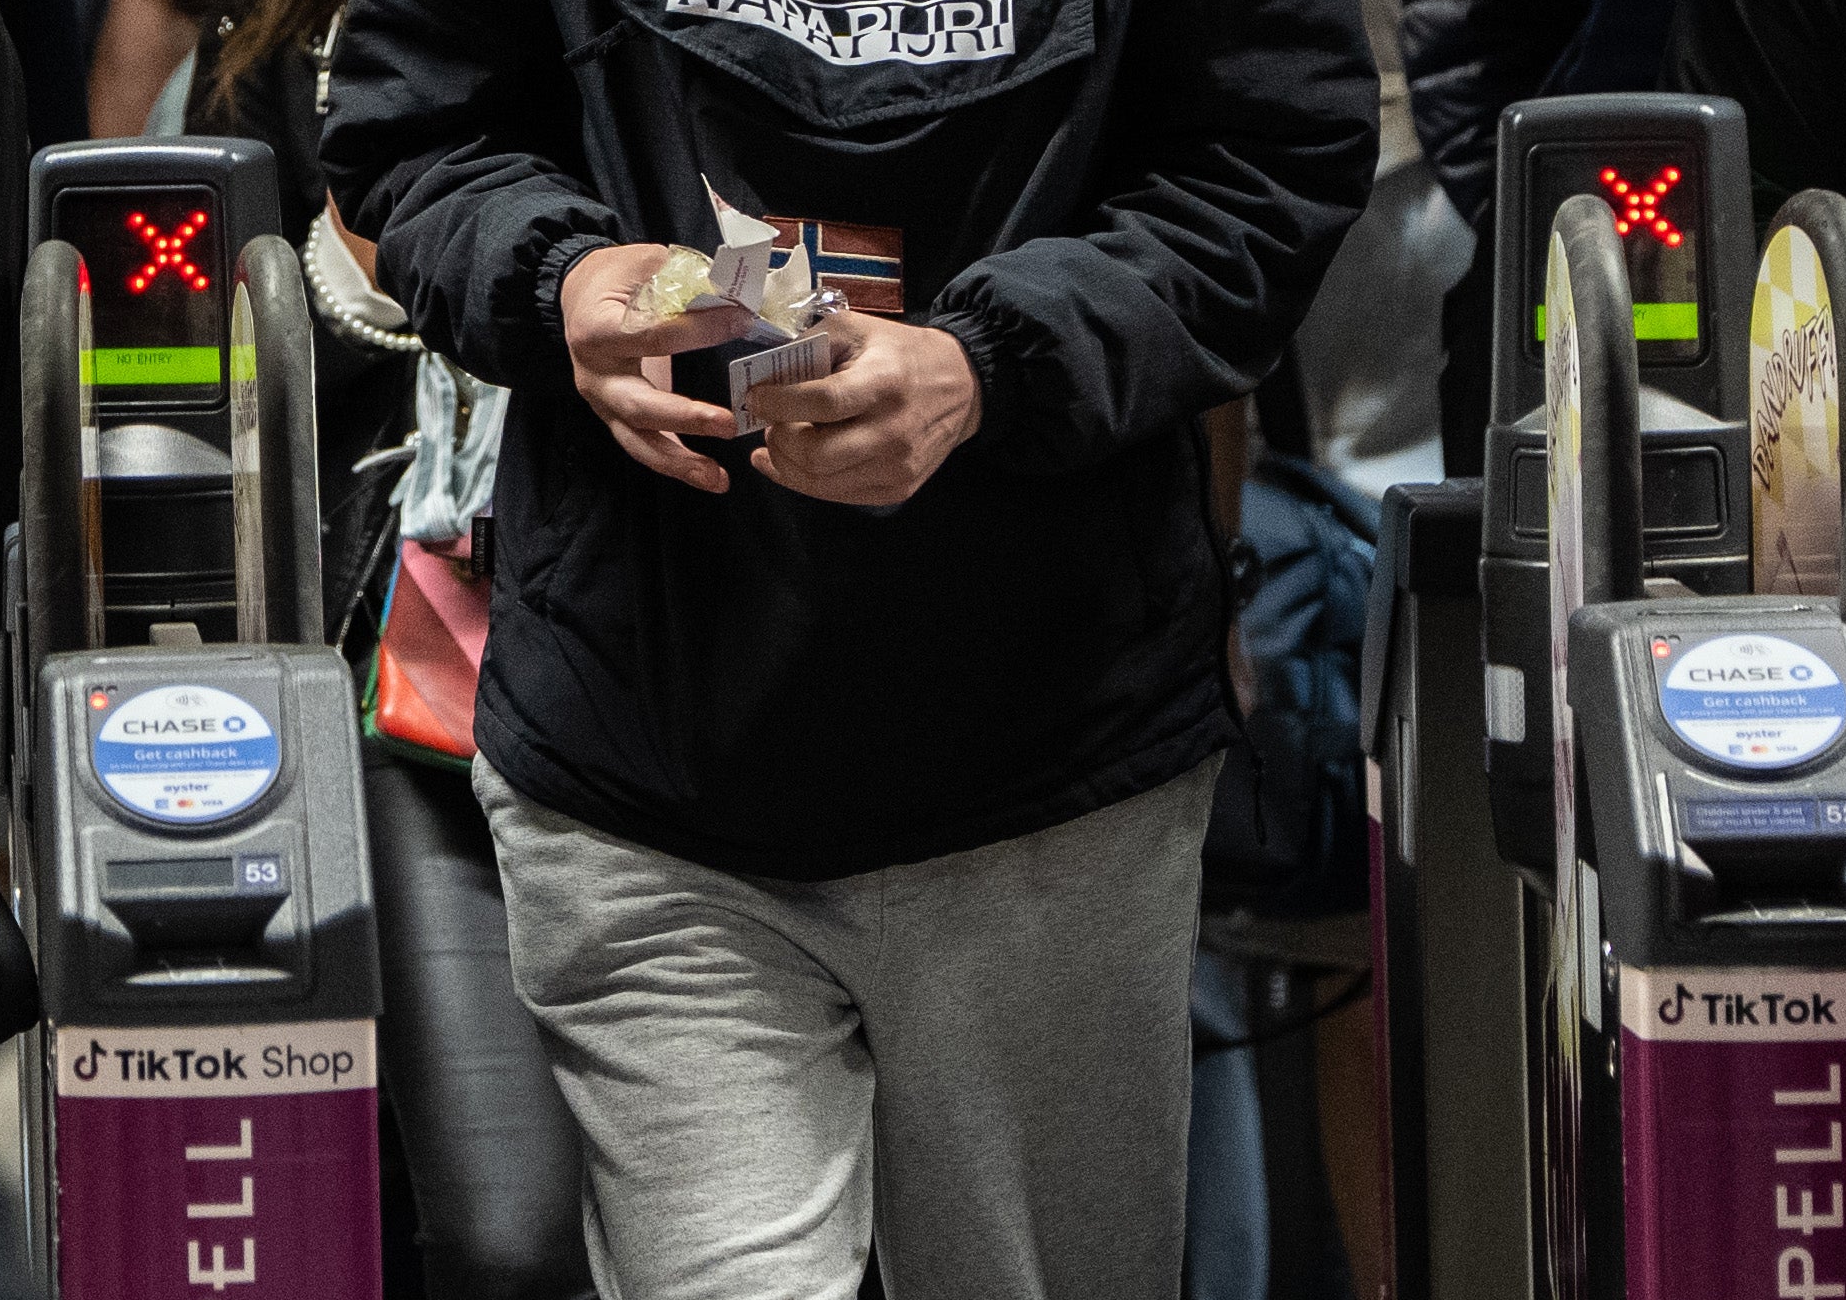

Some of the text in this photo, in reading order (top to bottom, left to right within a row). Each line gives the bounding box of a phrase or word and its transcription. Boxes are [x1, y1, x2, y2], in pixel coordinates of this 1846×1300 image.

[1689, 667, 1784, 682] CHASE
[1704, 693, 1808, 708] Get cashback
[123, 718, 217, 735] CHASE
[134, 745, 238, 761] Get cashback
[163, 781, 211, 794] oyster
[245, 862, 278, 882] 53
[1702, 992, 1836, 1026] TikTok
[115, 1044, 354, 1084] TikTok Shop
